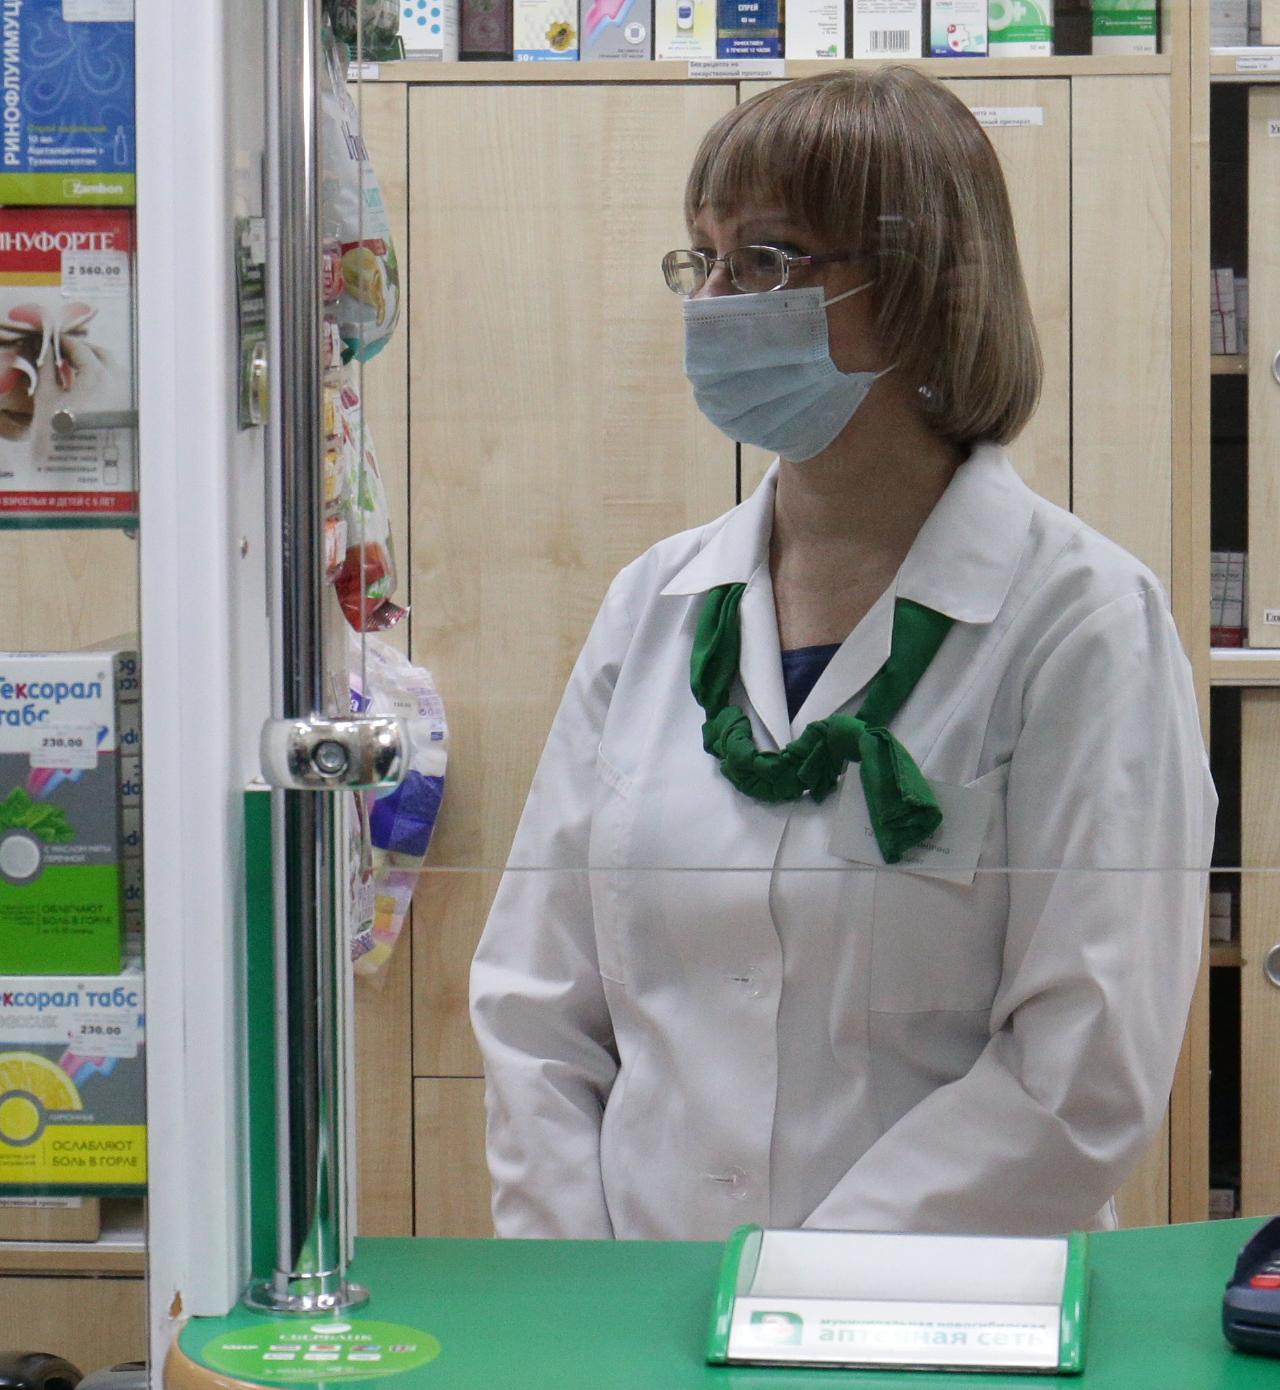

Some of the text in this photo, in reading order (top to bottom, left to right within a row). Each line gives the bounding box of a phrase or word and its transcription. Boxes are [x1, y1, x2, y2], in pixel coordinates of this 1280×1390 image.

[85, 986, 138, 1008] табс
[52, 1140, 134, 1151] ОСЛАБЛЯЮТ
[52, 1156, 86, 1168] БОЛЬ
[89, 1156, 97, 1167] В
[100, 1156, 138, 1168] ГОРЛЕ
[977, 1331, 1044, 1347] сеть
